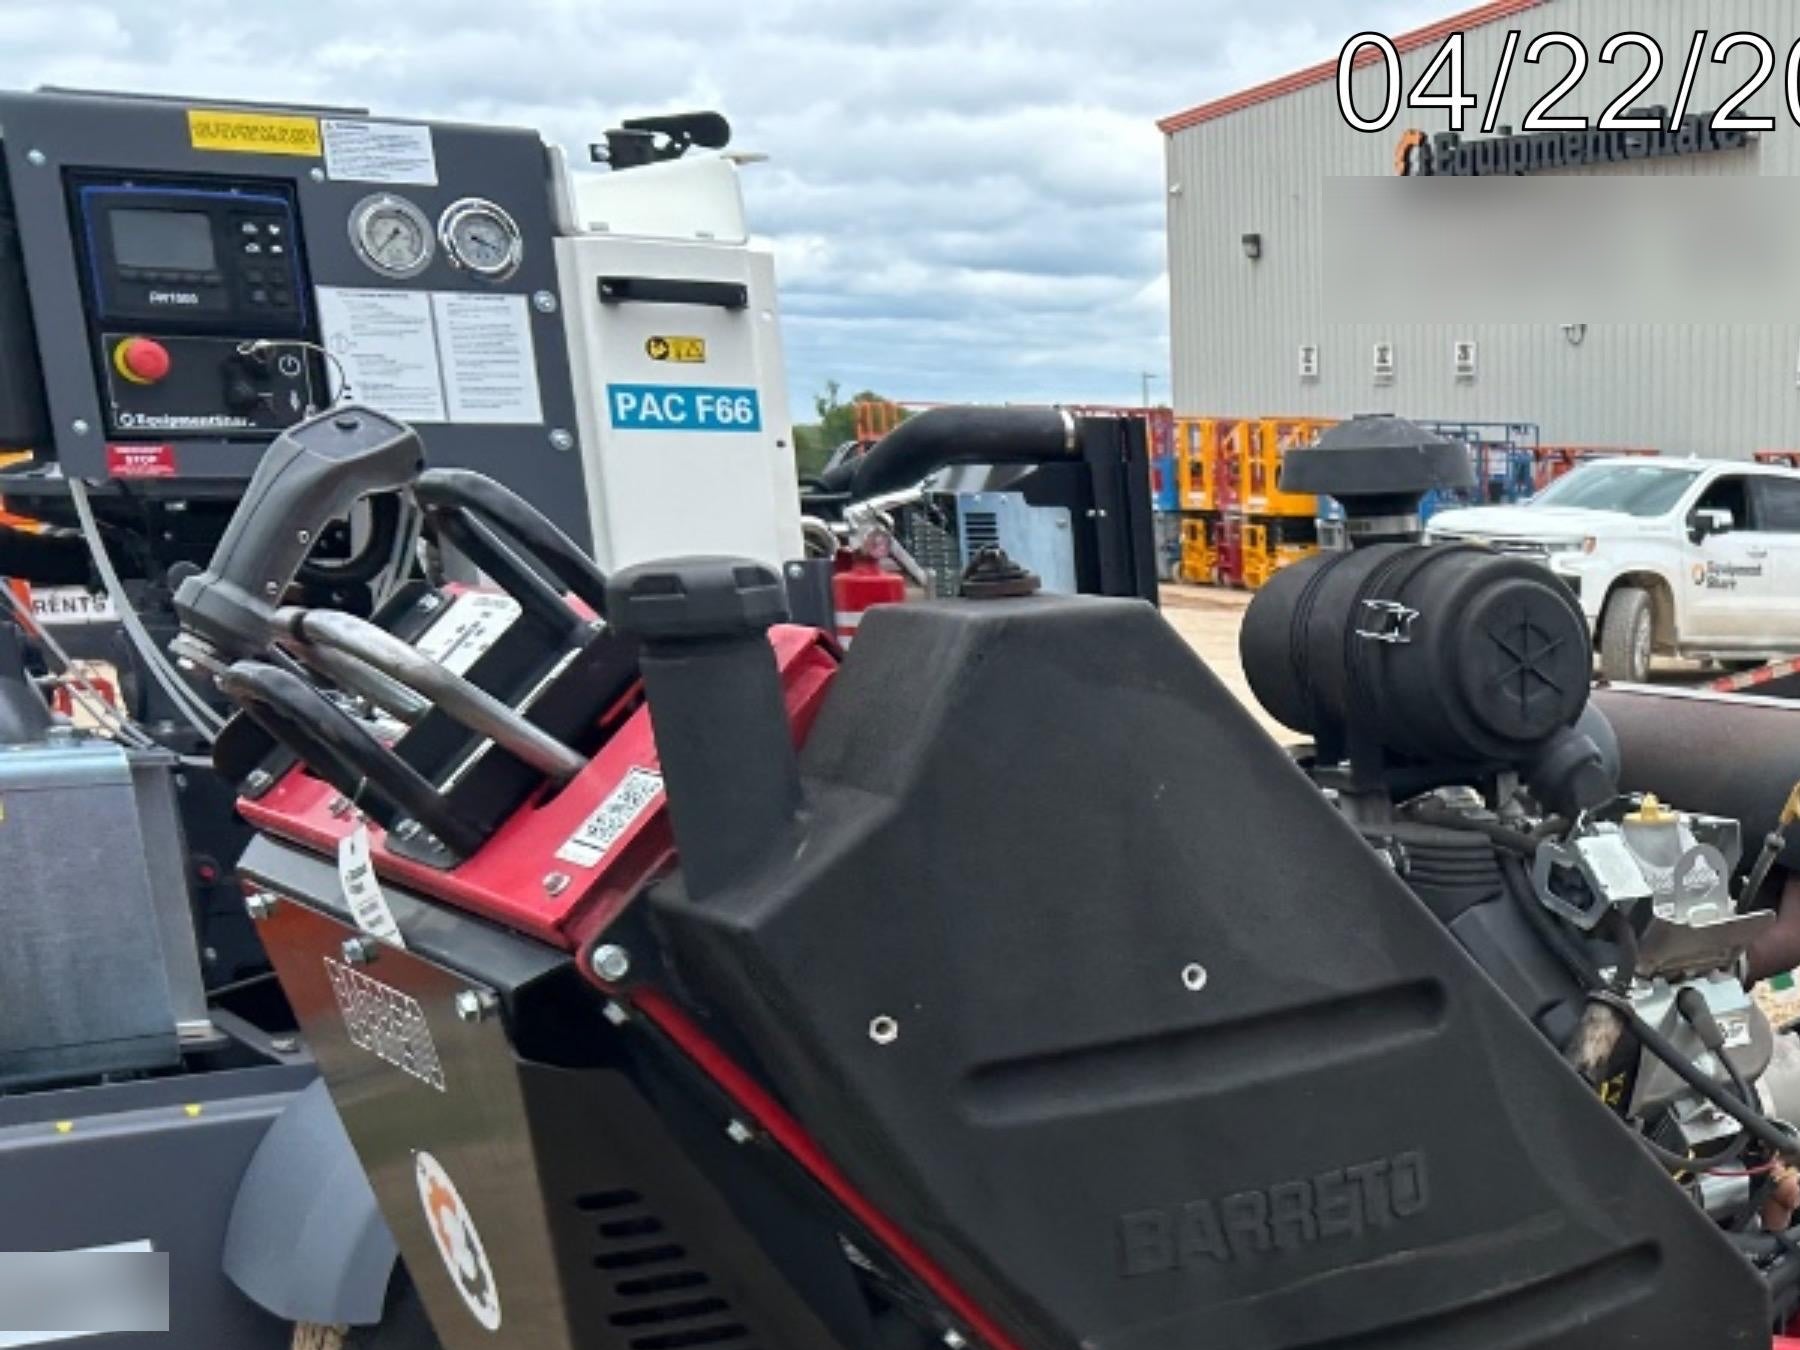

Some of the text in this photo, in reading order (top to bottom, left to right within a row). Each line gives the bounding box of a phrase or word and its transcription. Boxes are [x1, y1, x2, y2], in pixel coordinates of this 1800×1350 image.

[614, 391, 754, 424] PAC F66
[1115, 1148, 1429, 1280] BARRETO
